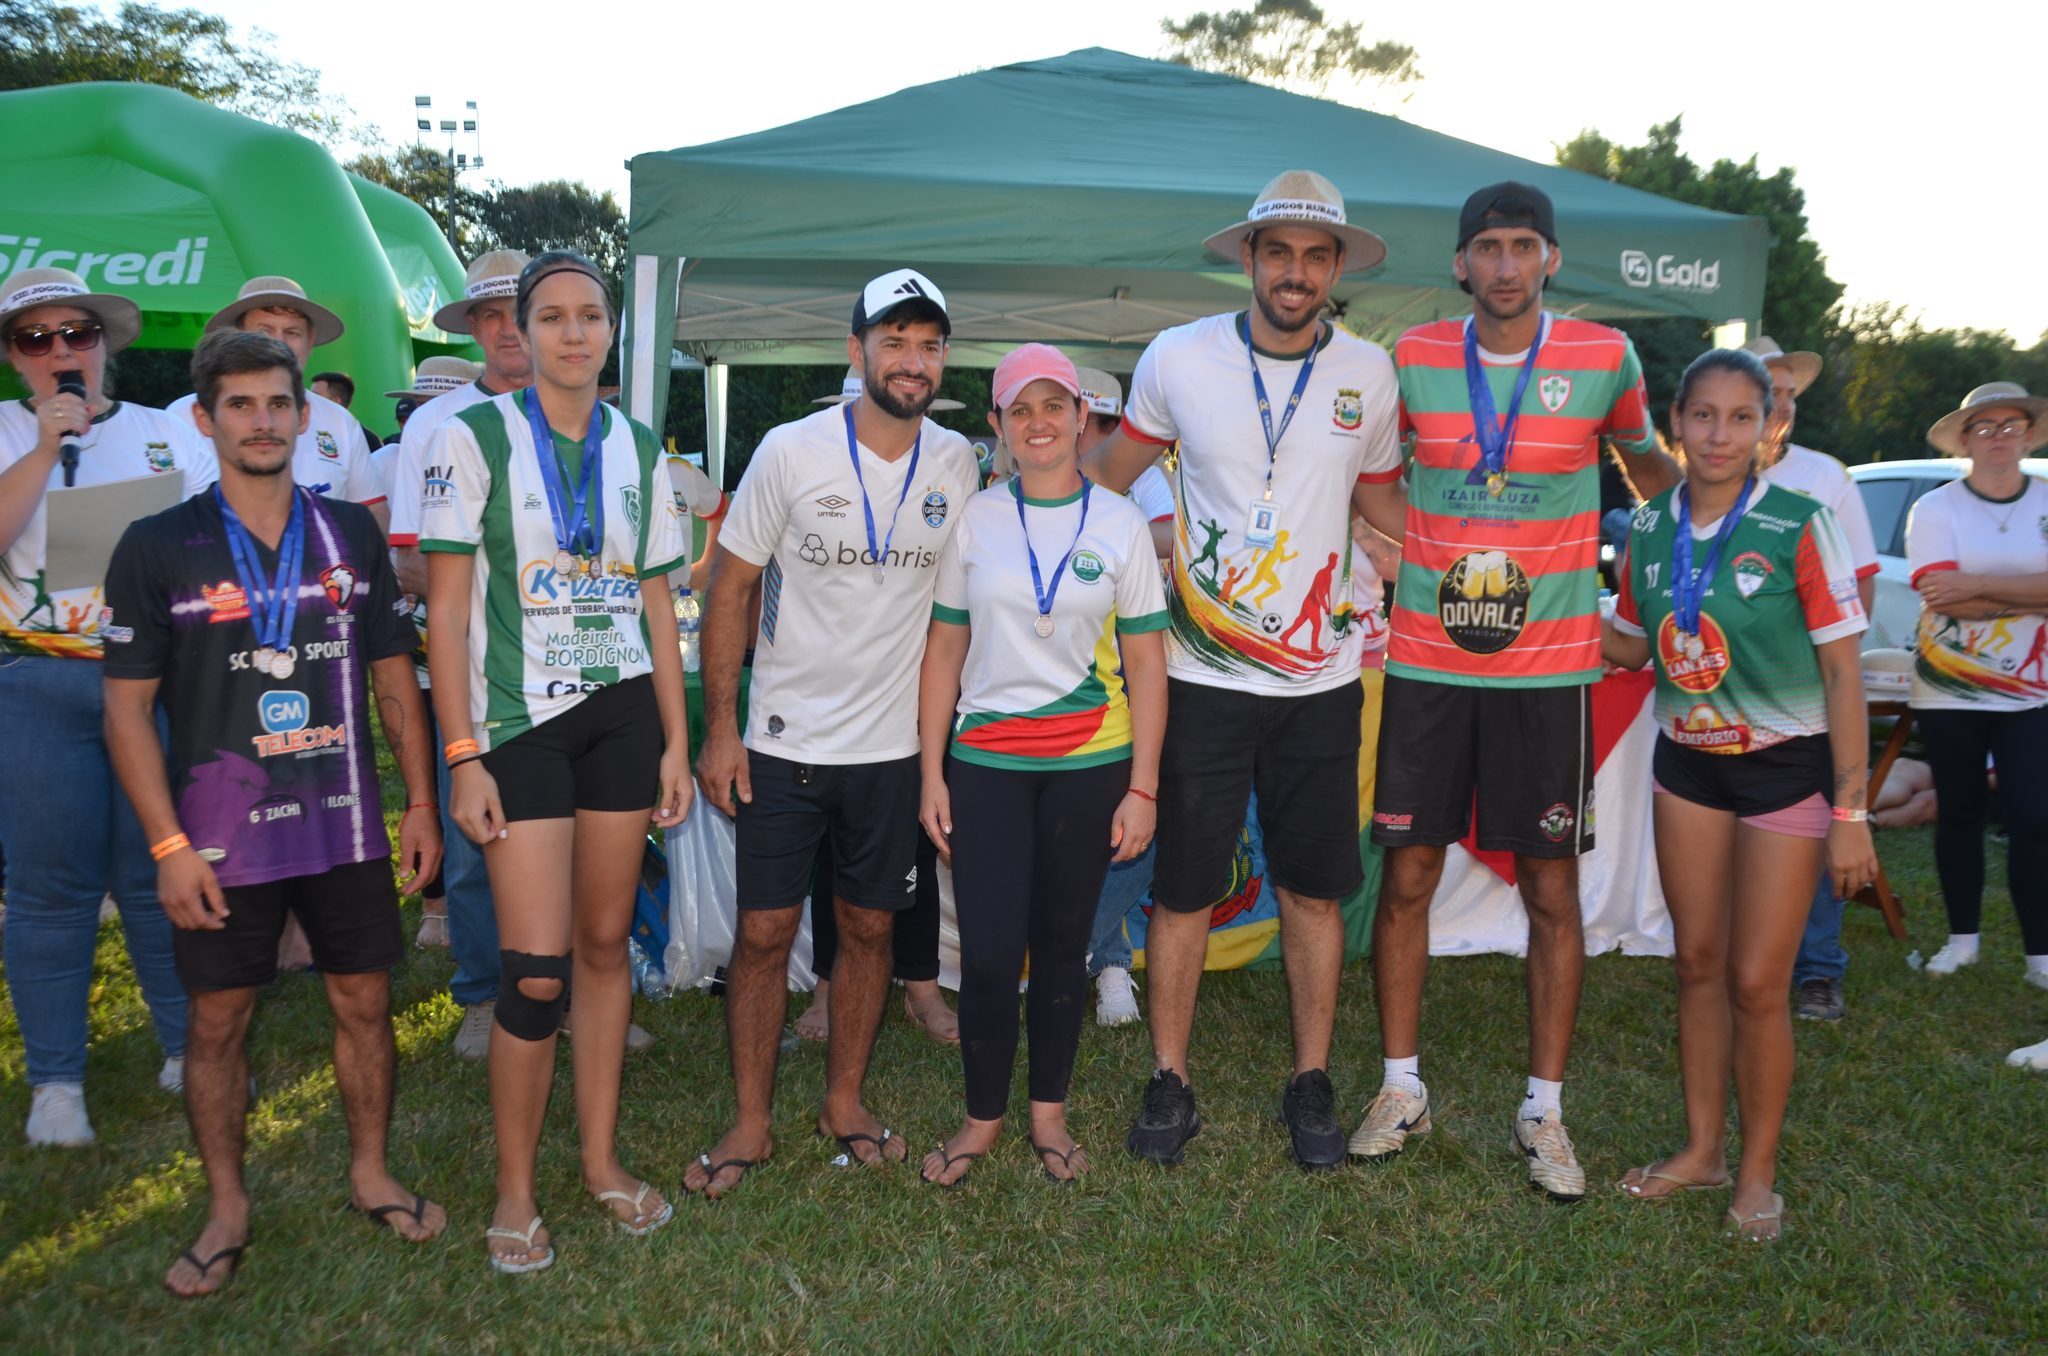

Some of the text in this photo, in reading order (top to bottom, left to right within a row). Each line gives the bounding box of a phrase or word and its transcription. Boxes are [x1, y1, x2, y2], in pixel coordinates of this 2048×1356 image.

[1270, 202, 1303, 210] JOGOS
[1656, 254, 1720, 288] Gold
[482, 279, 510, 289] JOGOS
[1442, 489, 1488, 502] IZAIR
[817, 510, 846, 518] umbro
[524, 605, 560, 618] SERVIÇOS
[562, 605, 573, 615] DE
[1443, 602, 1524, 631] DOVALE
[305, 640, 350, 660] SPORT
[545, 647, 646, 667] BORDIGNON
[229, 651, 250, 671] SC
[1667, 652, 1726, 677] LANHES
[267, 701, 303, 722] GM
[252, 723, 346, 758] TELECOM
[1677, 728, 1740, 744] EMPÓRIO
